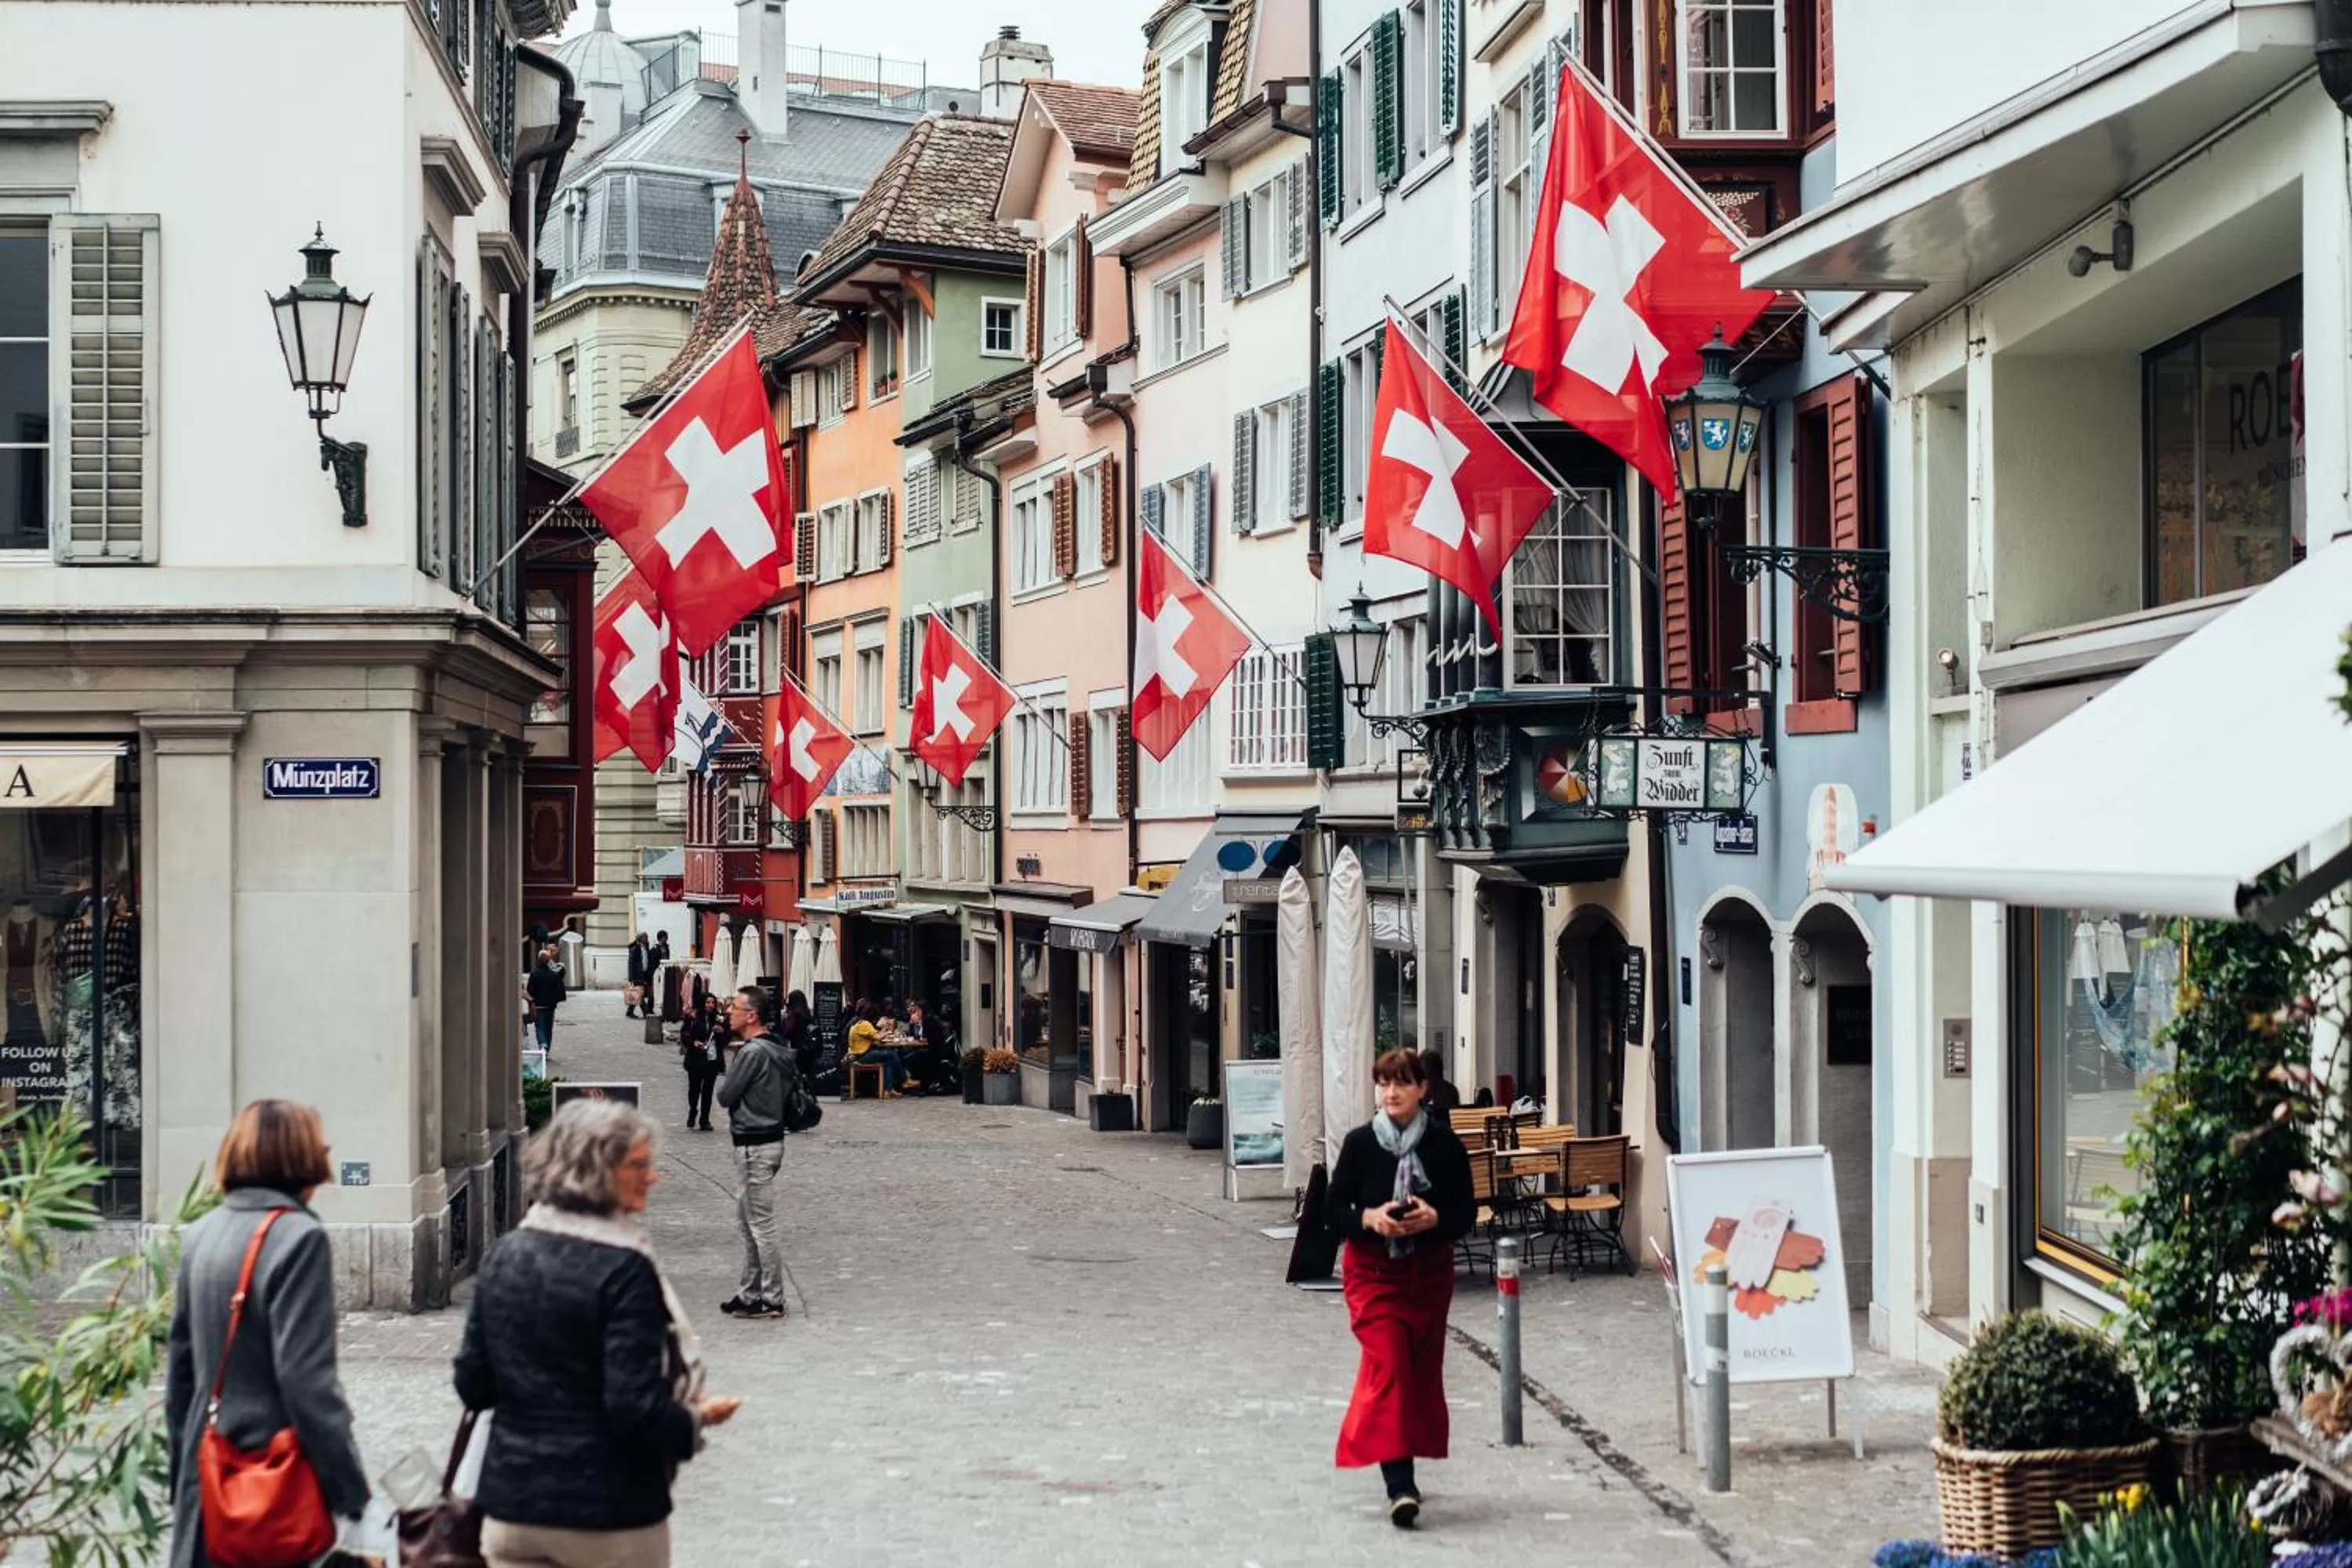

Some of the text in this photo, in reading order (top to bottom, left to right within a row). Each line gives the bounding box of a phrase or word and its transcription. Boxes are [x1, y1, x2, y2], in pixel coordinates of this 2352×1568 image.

[1646, 744, 1699, 769] Zunft
[4, 764, 38, 797] A
[274, 763, 369, 794] Münzplatz
[1643, 778, 1700, 801] Widder
[2, 1047, 59, 1058] FOLLOW
[29, 1062, 52, 1073] ON
[2, 1076, 78, 1088] INSTAGRA
